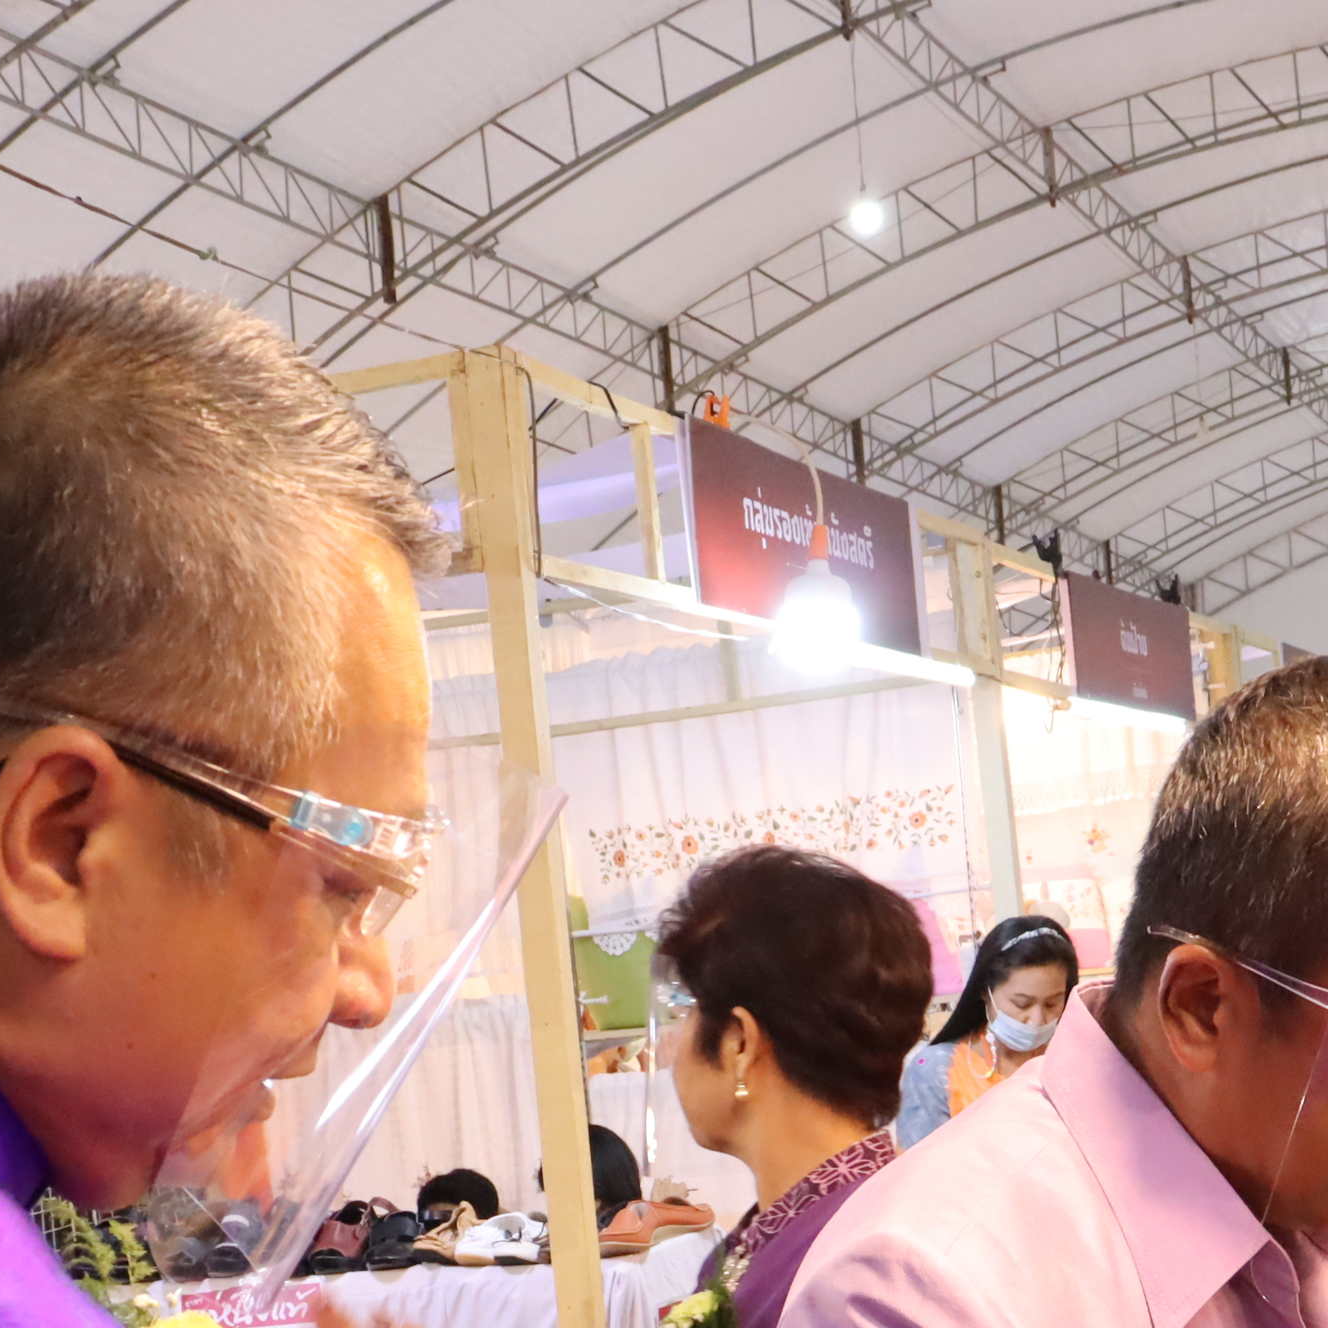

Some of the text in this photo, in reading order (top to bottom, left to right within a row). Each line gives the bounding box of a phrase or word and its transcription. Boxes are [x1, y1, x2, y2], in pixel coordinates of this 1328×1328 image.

[743, 486, 875, 569] กลุ่มรองเท้นังสตรี
